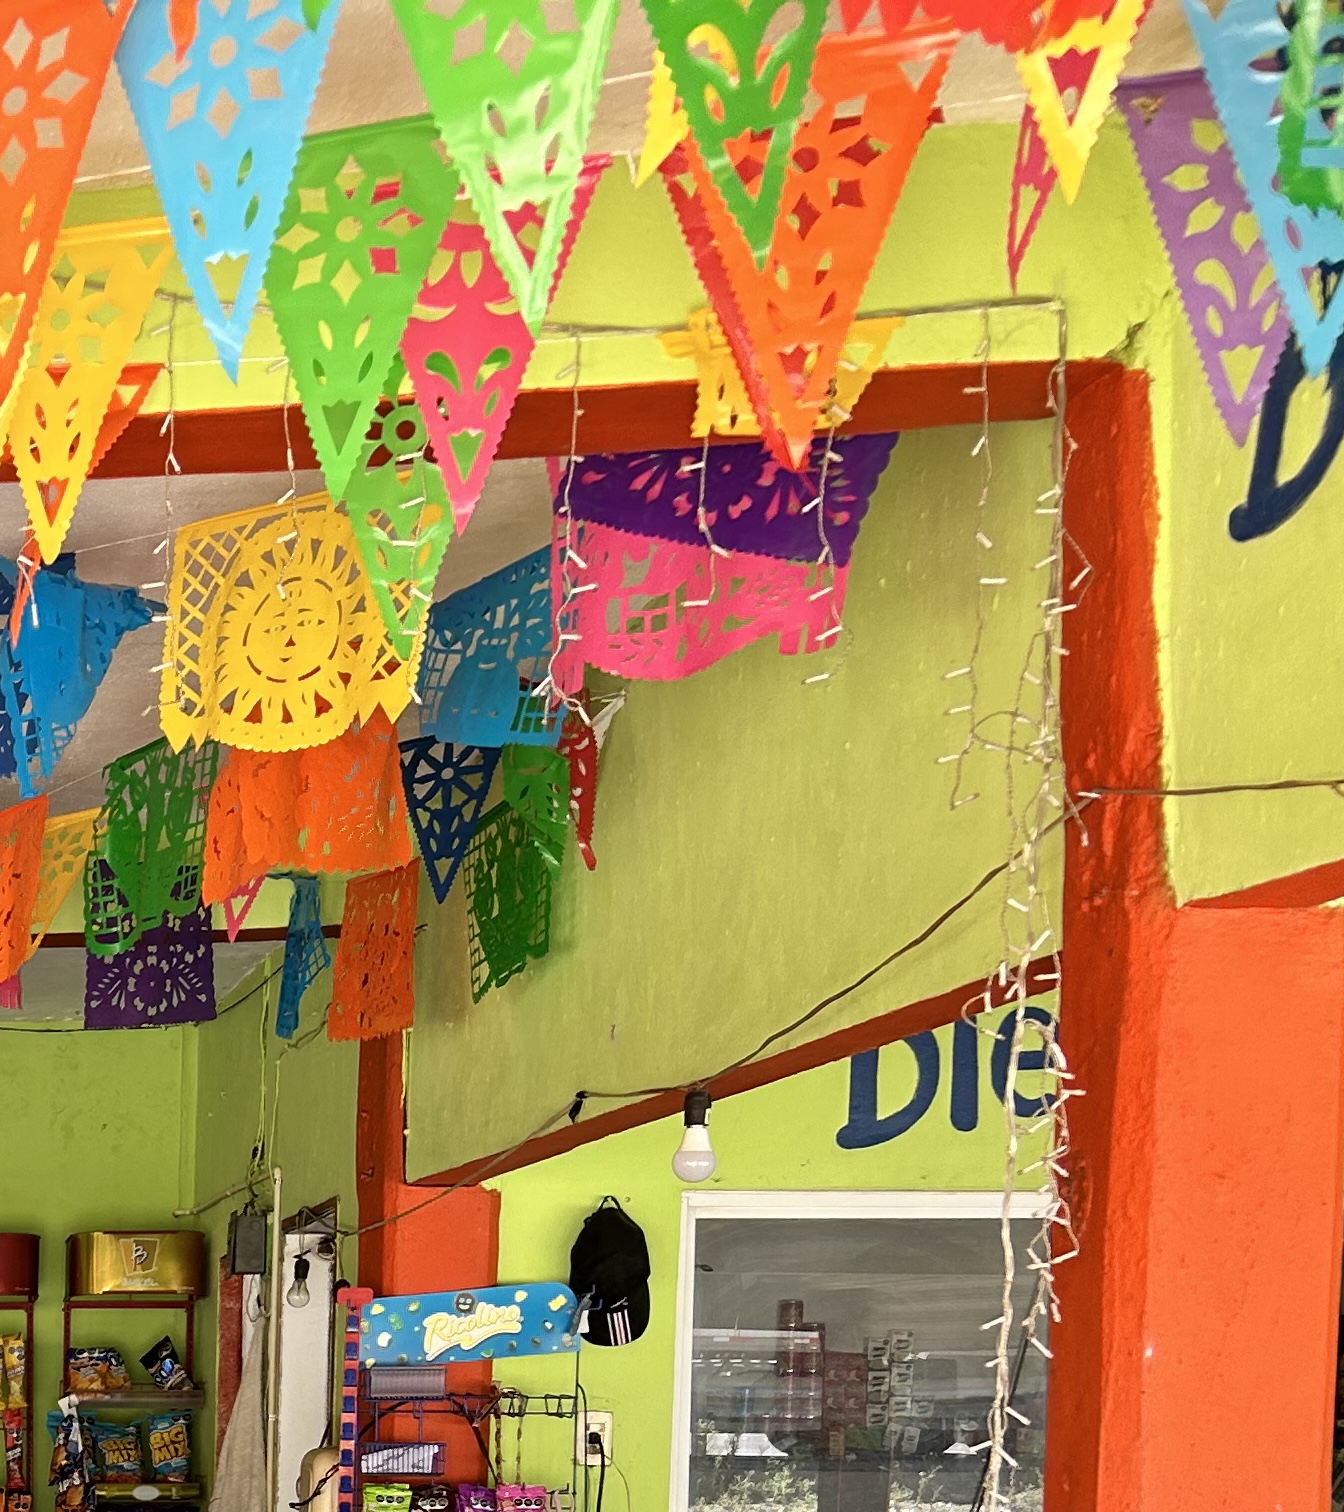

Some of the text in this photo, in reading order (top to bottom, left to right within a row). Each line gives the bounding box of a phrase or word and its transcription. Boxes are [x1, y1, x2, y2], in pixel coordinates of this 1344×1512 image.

[423, 1302, 520, 1357] Ricolino
[100, 1438, 137, 1451] BIG
[150, 1426, 185, 1447] BIG
[154, 1441, 188, 1465] MIX
